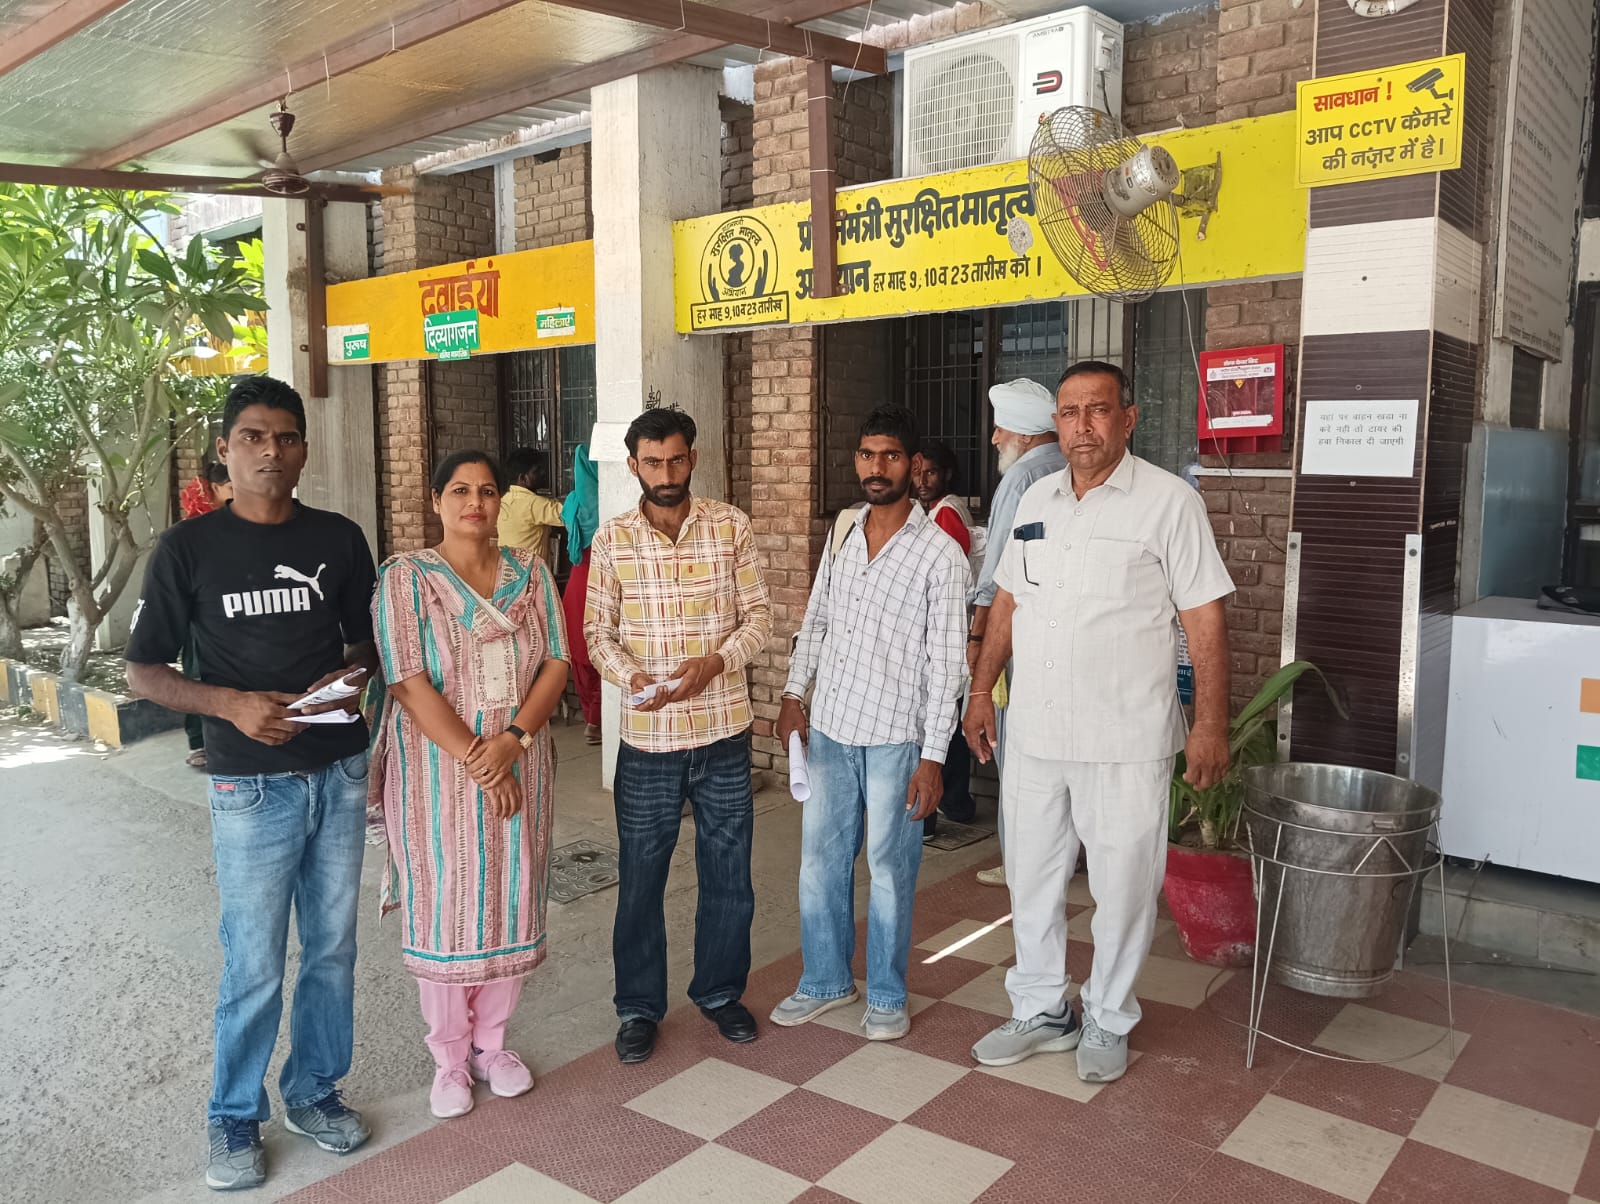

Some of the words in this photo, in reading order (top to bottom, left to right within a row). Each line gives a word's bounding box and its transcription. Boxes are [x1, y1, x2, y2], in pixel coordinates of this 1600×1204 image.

[1313, 86, 1380, 112] सावधान
[1305, 124, 1344, 145] आप
[1349, 117, 1397, 138] CCTV
[1322, 147, 1347, 171] की
[1400, 137, 1419, 160] में
[885, 188, 962, 248] सुरक्षित
[874, 272, 885, 292] हर
[888, 270, 906, 291] माह
[971, 254, 1008, 284] तारीख
[696, 309, 707, 324] हर
[709, 307, 723, 321] माह
[424, 315, 477, 350] दिव्यांगजन
[222, 587, 311, 618] PUMA
